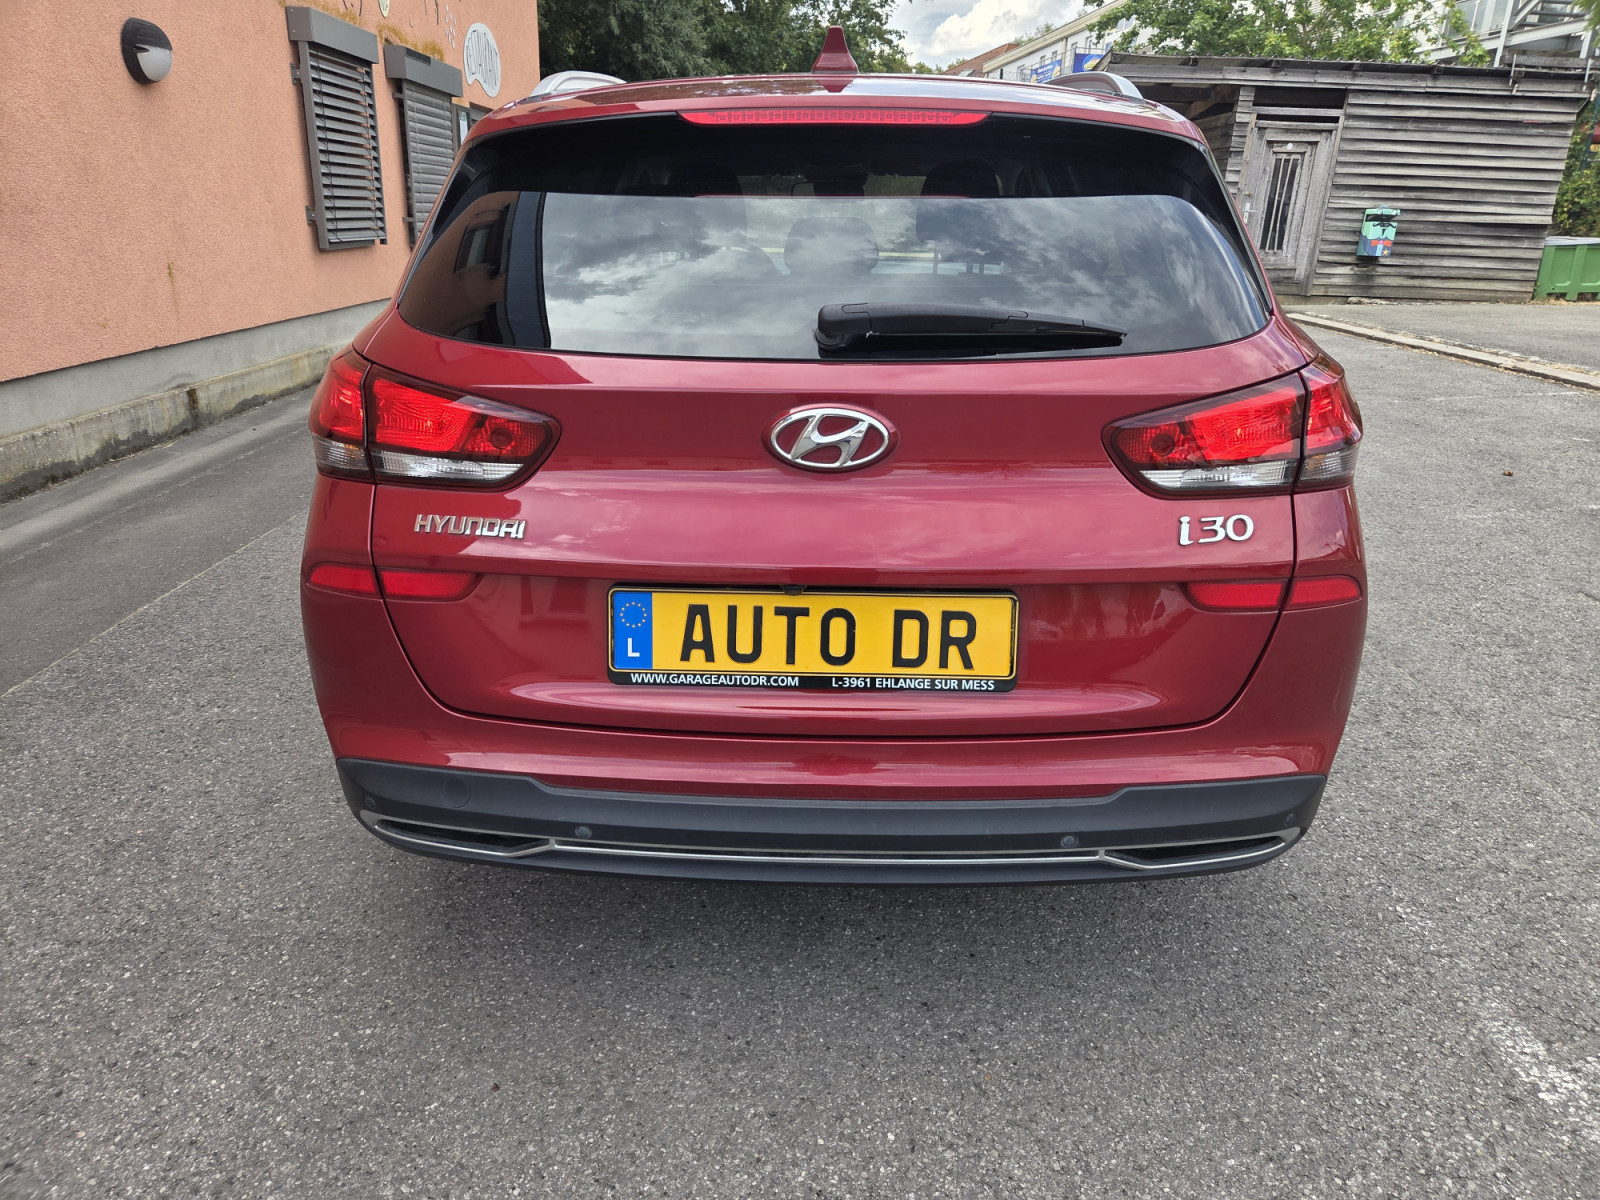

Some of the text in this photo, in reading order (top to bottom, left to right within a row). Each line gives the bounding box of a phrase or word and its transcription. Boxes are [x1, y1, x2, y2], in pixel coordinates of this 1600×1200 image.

[413, 514, 526, 539] HYUNDAI
[1179, 514, 1254, 546] i30
[627, 637, 640, 657] L
[680, 603, 975, 670] AUTO DR
[631, 673, 799, 687] WWW.GARAGEAUTODR.COM
[832, 677, 995, 691] L-3961 EHLANGE SUR MESS
